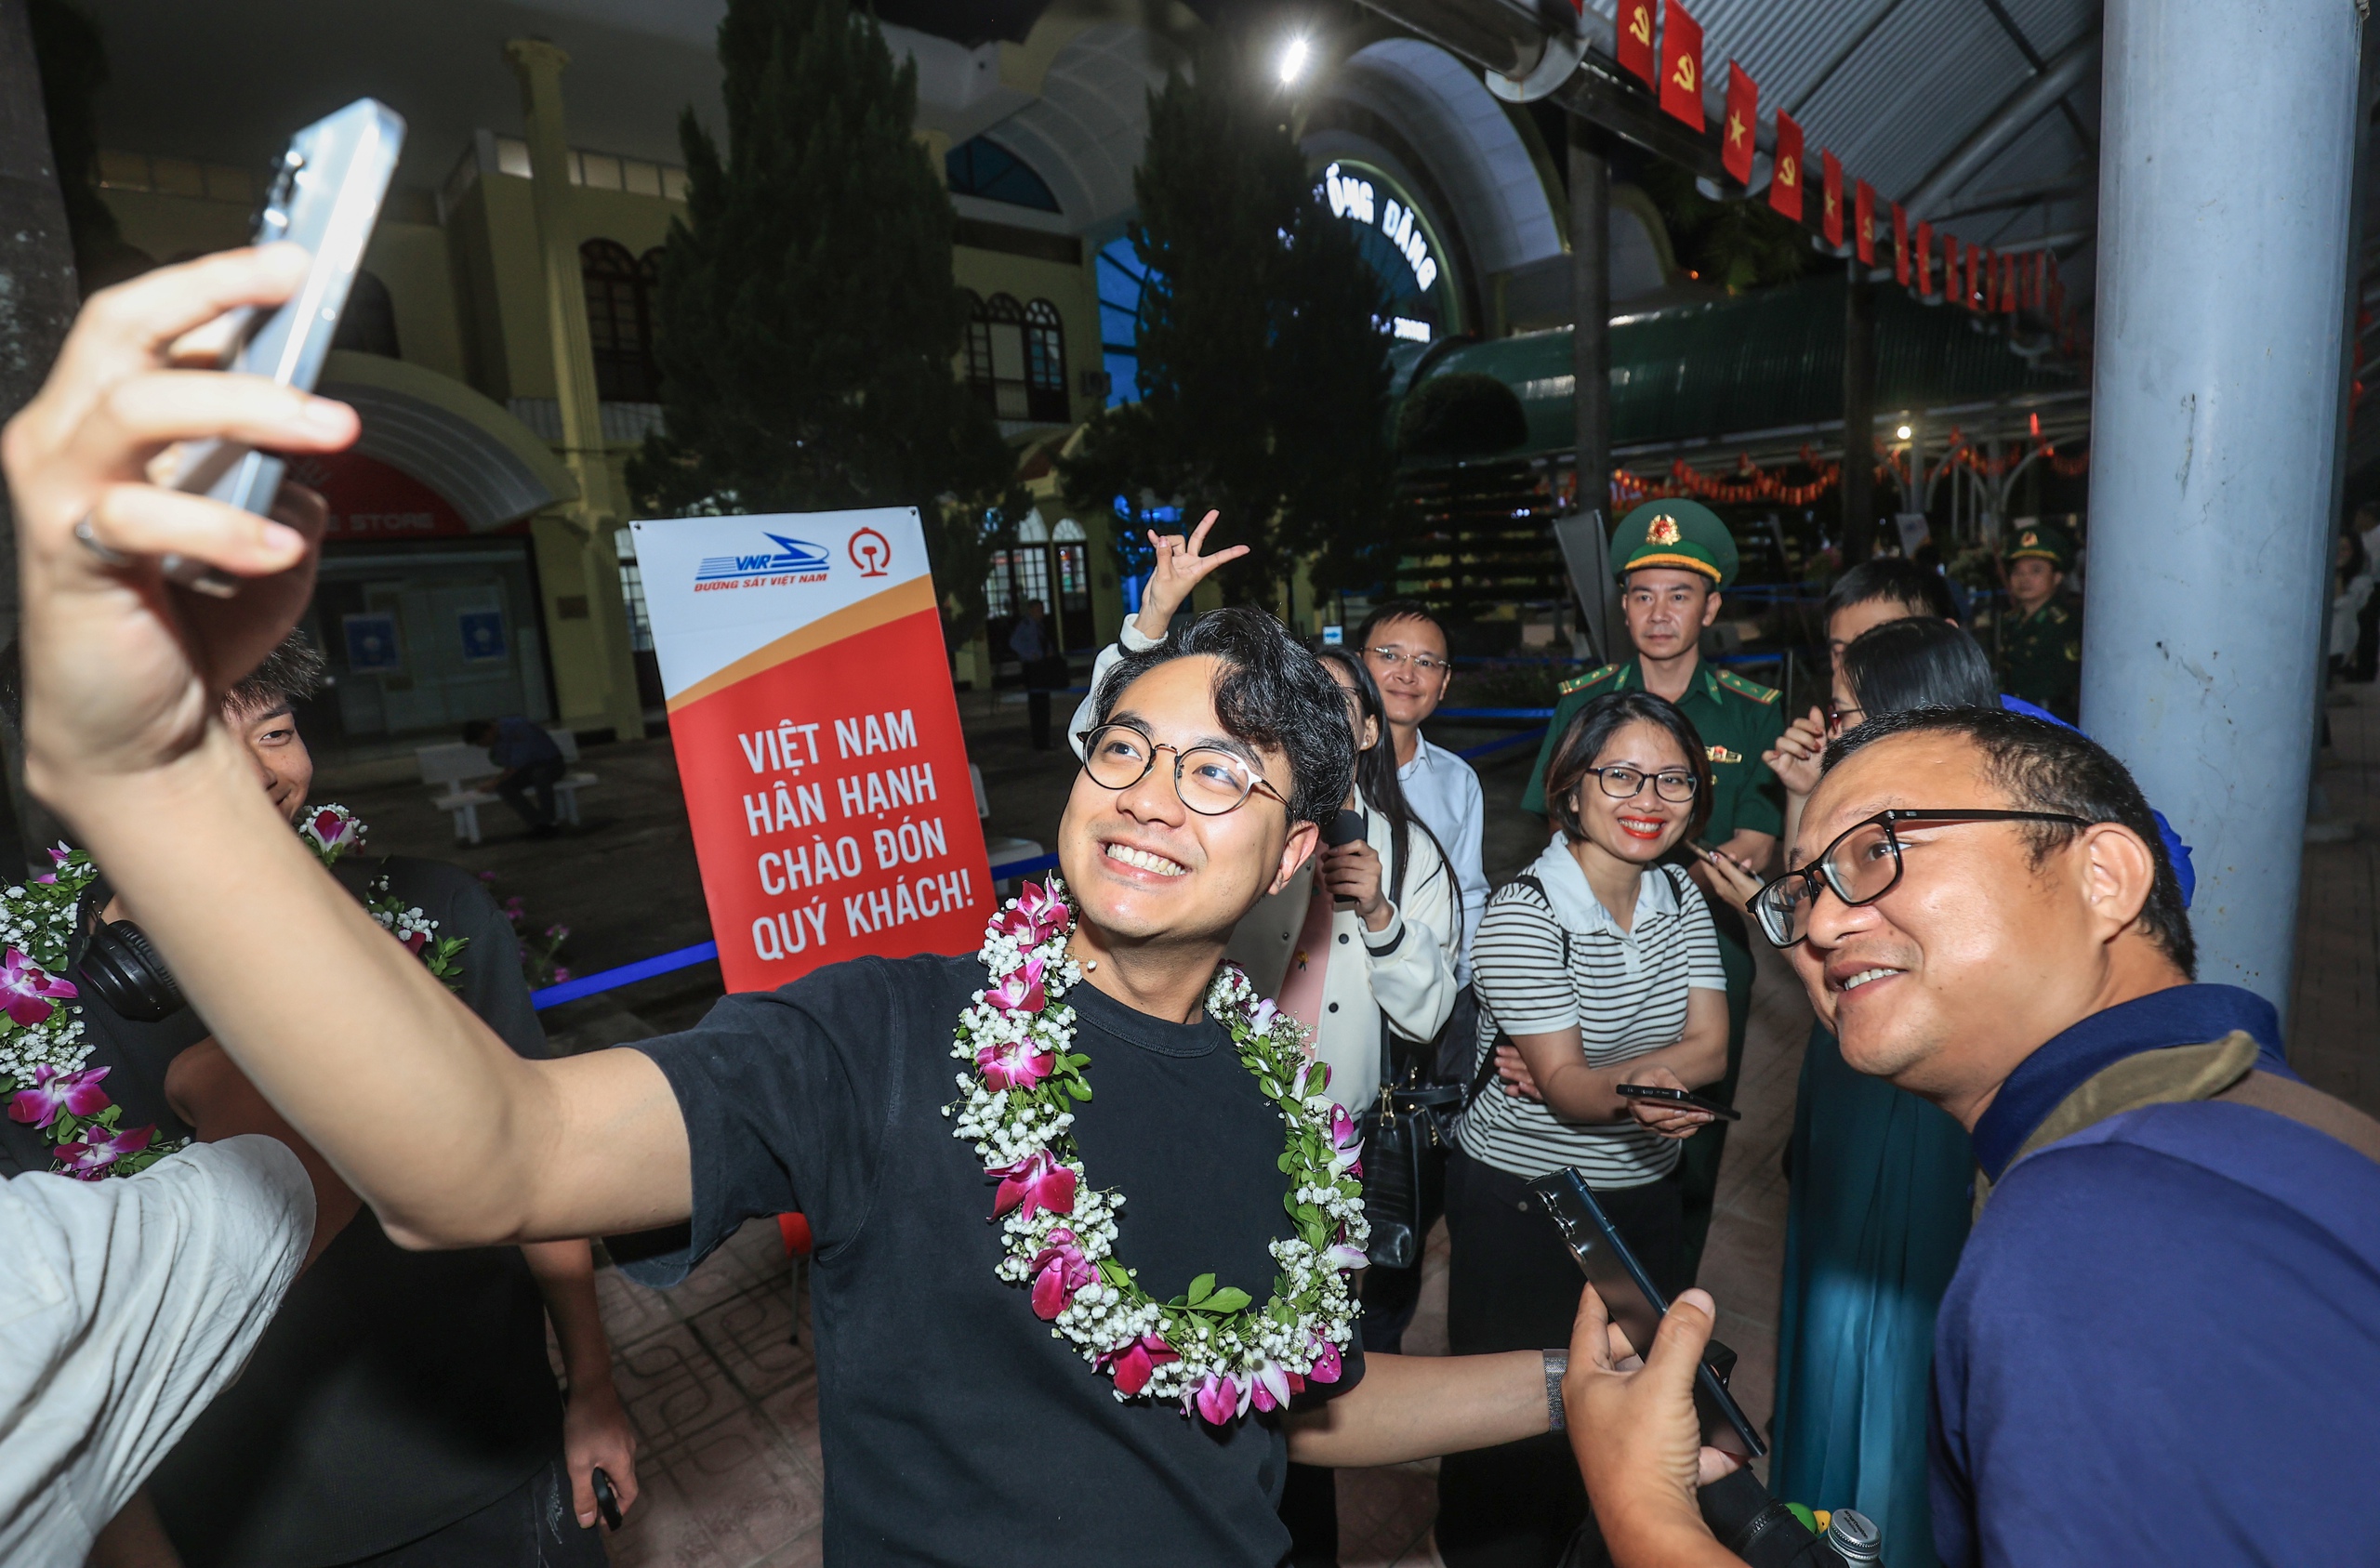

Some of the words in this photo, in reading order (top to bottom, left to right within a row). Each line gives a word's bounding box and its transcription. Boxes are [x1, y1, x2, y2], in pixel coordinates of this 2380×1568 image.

[349, 512, 435, 532] STORE
[734, 554, 774, 572] VNR
[771, 574, 797, 586] VIỆT
[799, 573, 828, 583] NAM
[738, 718, 820, 775] VIỆT
[835, 709, 918, 759] NAM
[743, 781, 826, 837] HÂN
[837, 762, 937, 820] HẠNH
[758, 835, 862, 896] CHÀO
[873, 815, 947, 870] ĐÓN
[751, 896, 827, 961] QUÝ
[843, 868, 974, 938] KHÁCH!
